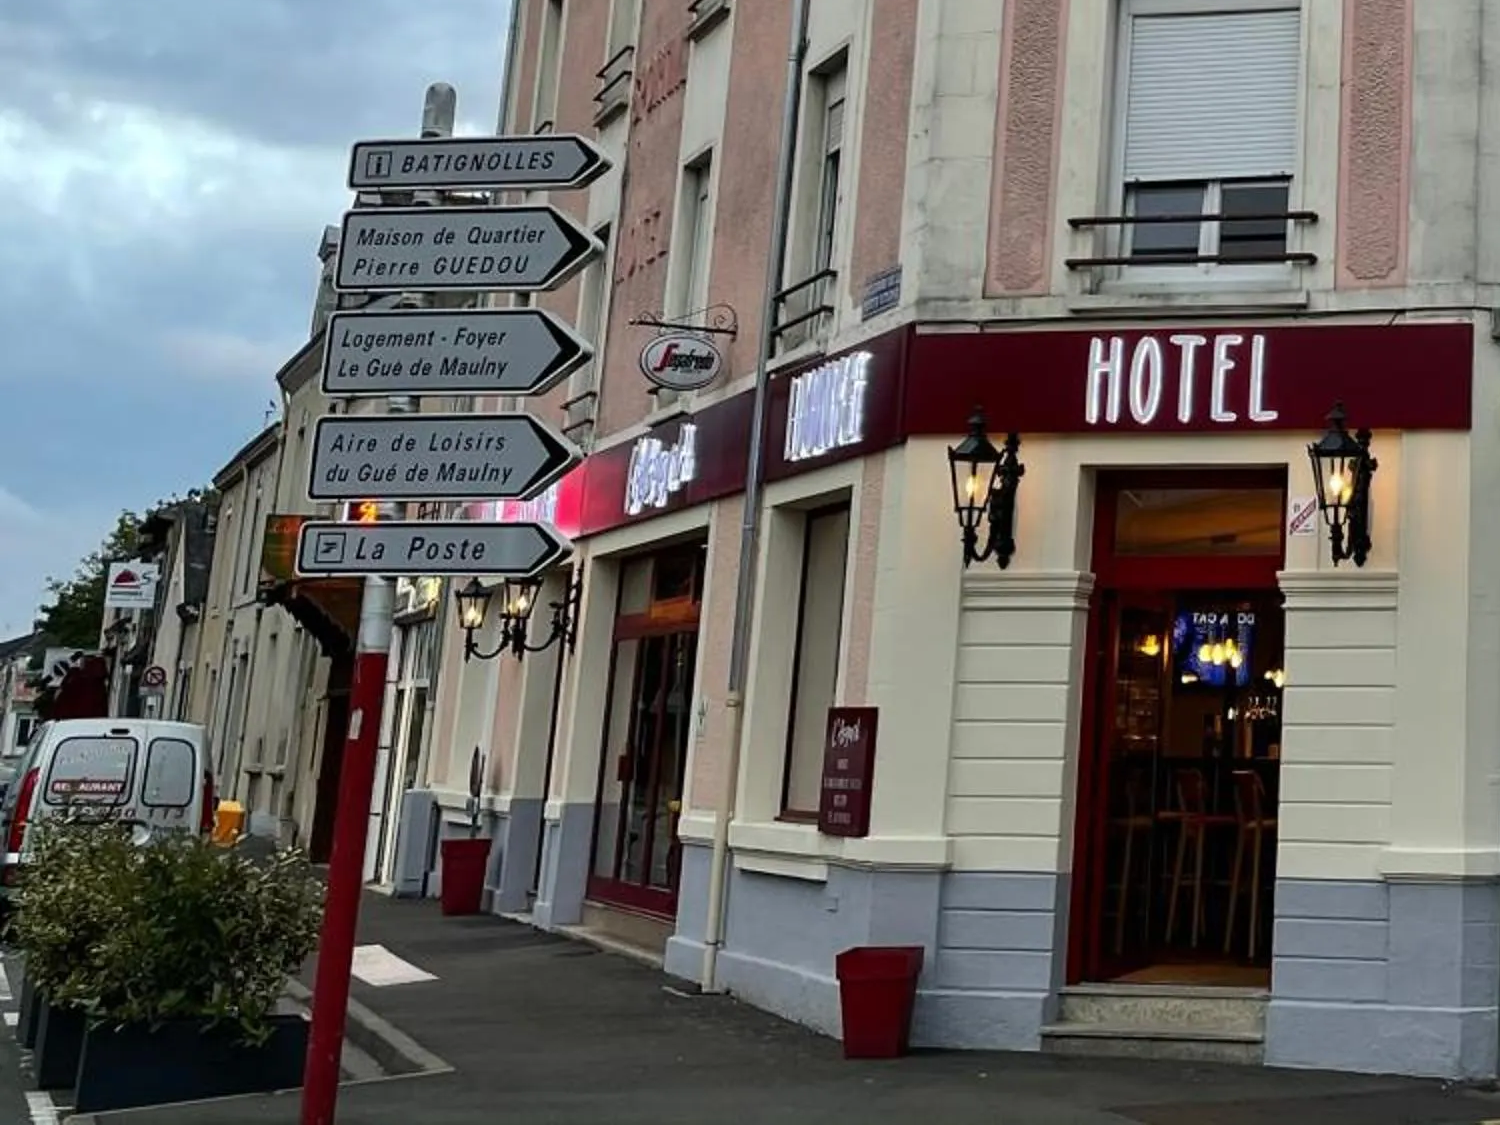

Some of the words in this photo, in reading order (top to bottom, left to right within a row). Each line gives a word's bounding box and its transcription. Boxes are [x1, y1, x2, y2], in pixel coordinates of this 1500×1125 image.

[401, 151, 555, 173] BATIGNOLLES
[356, 228, 424, 246] Maison
[433, 226, 456, 244] de
[467, 225, 547, 244] Quartier
[353, 258, 420, 276] Pierre
[433, 256, 530, 275] GUEDOU
[341, 329, 435, 352] Logement
[454, 327, 507, 350] Foyer
[338, 359, 359, 377] Le
[409, 357, 433, 376] de
[440, 356, 509, 379] Maulny
[1085, 333, 1279, 425] HOTEL
[330, 433, 377, 452] Aire
[391, 432, 417, 452] de
[429, 431, 506, 452] Loisirs
[325, 463, 349, 482] du
[357, 462, 397, 482] Gué
[405, 462, 430, 482] de
[435, 461, 514, 485] Maulny
[355, 536, 385, 560] La
[408, 536, 487, 560] Poste
[53, 781, 124, 792] REAURANT
